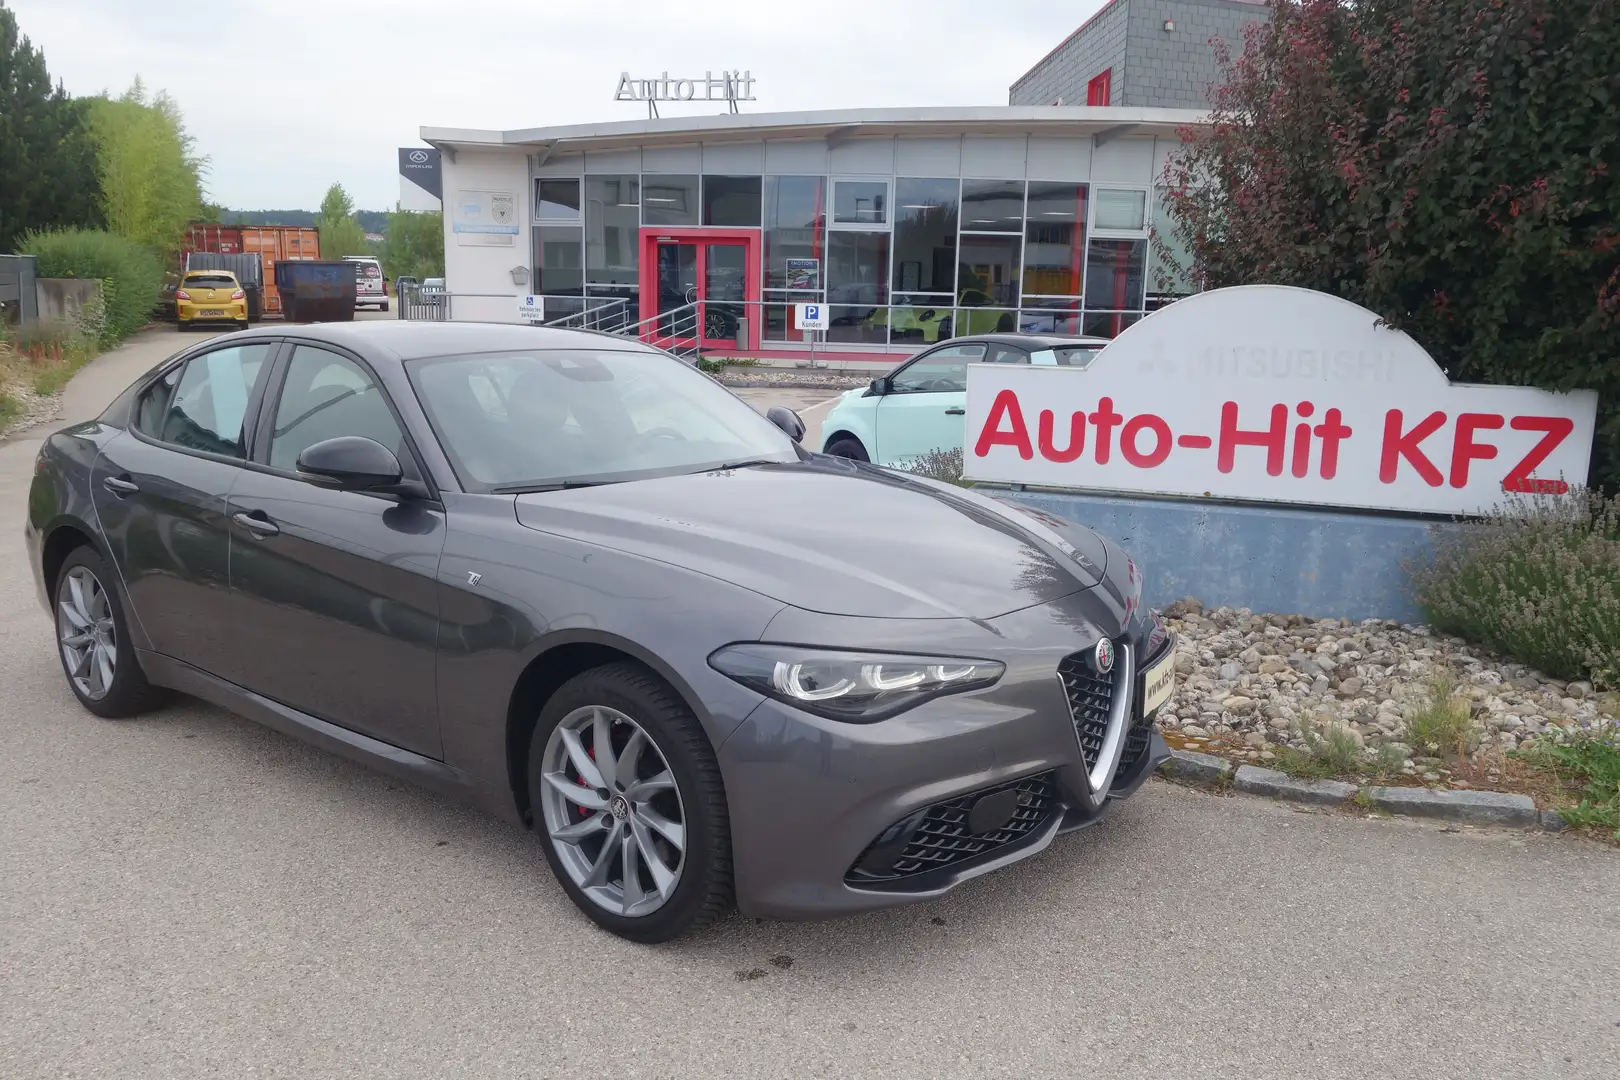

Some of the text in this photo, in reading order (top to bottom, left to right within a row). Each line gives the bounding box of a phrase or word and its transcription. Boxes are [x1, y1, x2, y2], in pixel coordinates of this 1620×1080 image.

[613, 69, 757, 101] Auto Hit
[974, 389, 1574, 495] Auto-Hit KFZ
